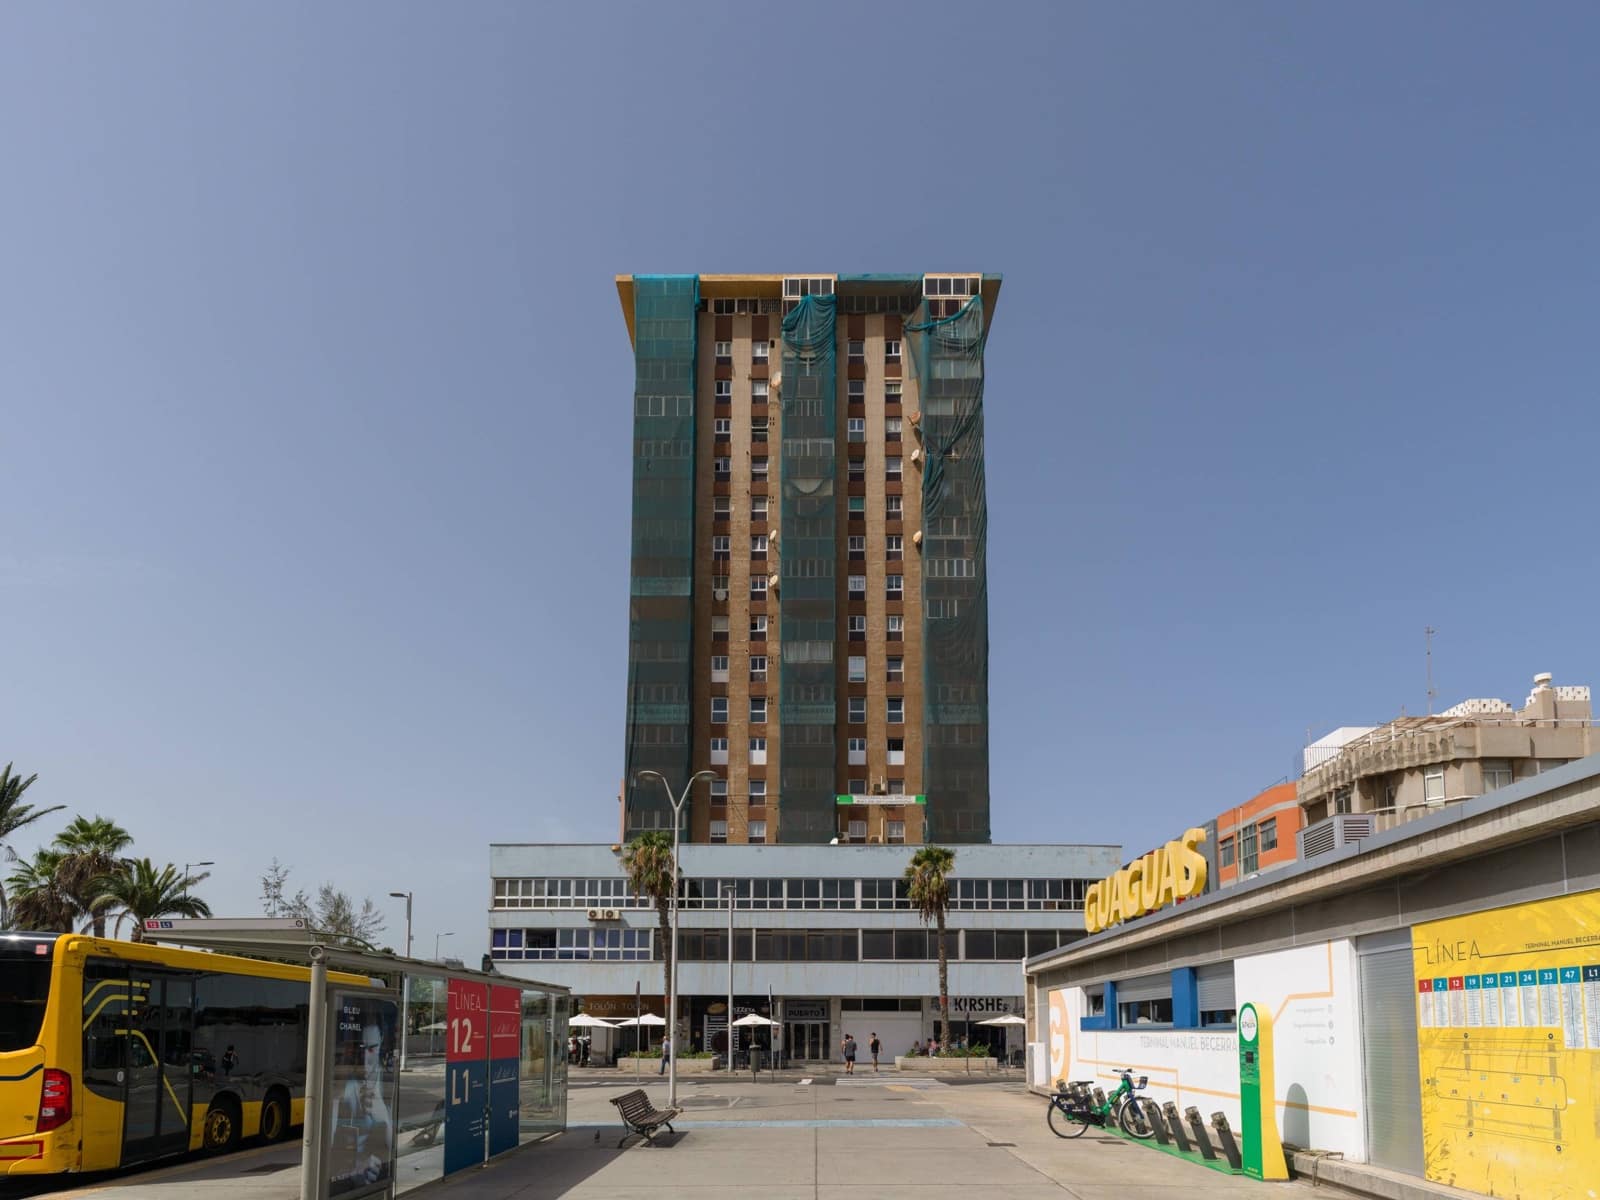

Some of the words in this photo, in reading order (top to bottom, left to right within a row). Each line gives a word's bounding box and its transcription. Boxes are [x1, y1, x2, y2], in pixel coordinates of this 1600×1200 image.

[1084, 828, 1207, 933] GUAGUAS
[1427, 938, 1481, 965] LÍNEA
[1452, 979, 1460, 987] 12
[1486, 977, 1494, 985] 20
[1504, 975, 1513, 983] 21
[1543, 972, 1553, 980] 33
[1565, 970, 1575, 979] 47
[1588, 969, 1598, 977] L1
[343, 1006, 361, 1015] BLEU
[456, 986, 481, 1013] LÍNEA
[788, 1009, 820, 1017] PUERTO
[339, 1022, 362, 1032] CHANEL
[451, 1017, 472, 1054] 12
[1200, 1036, 1238, 1052] BECERRA
[451, 1068, 470, 1106] L1
